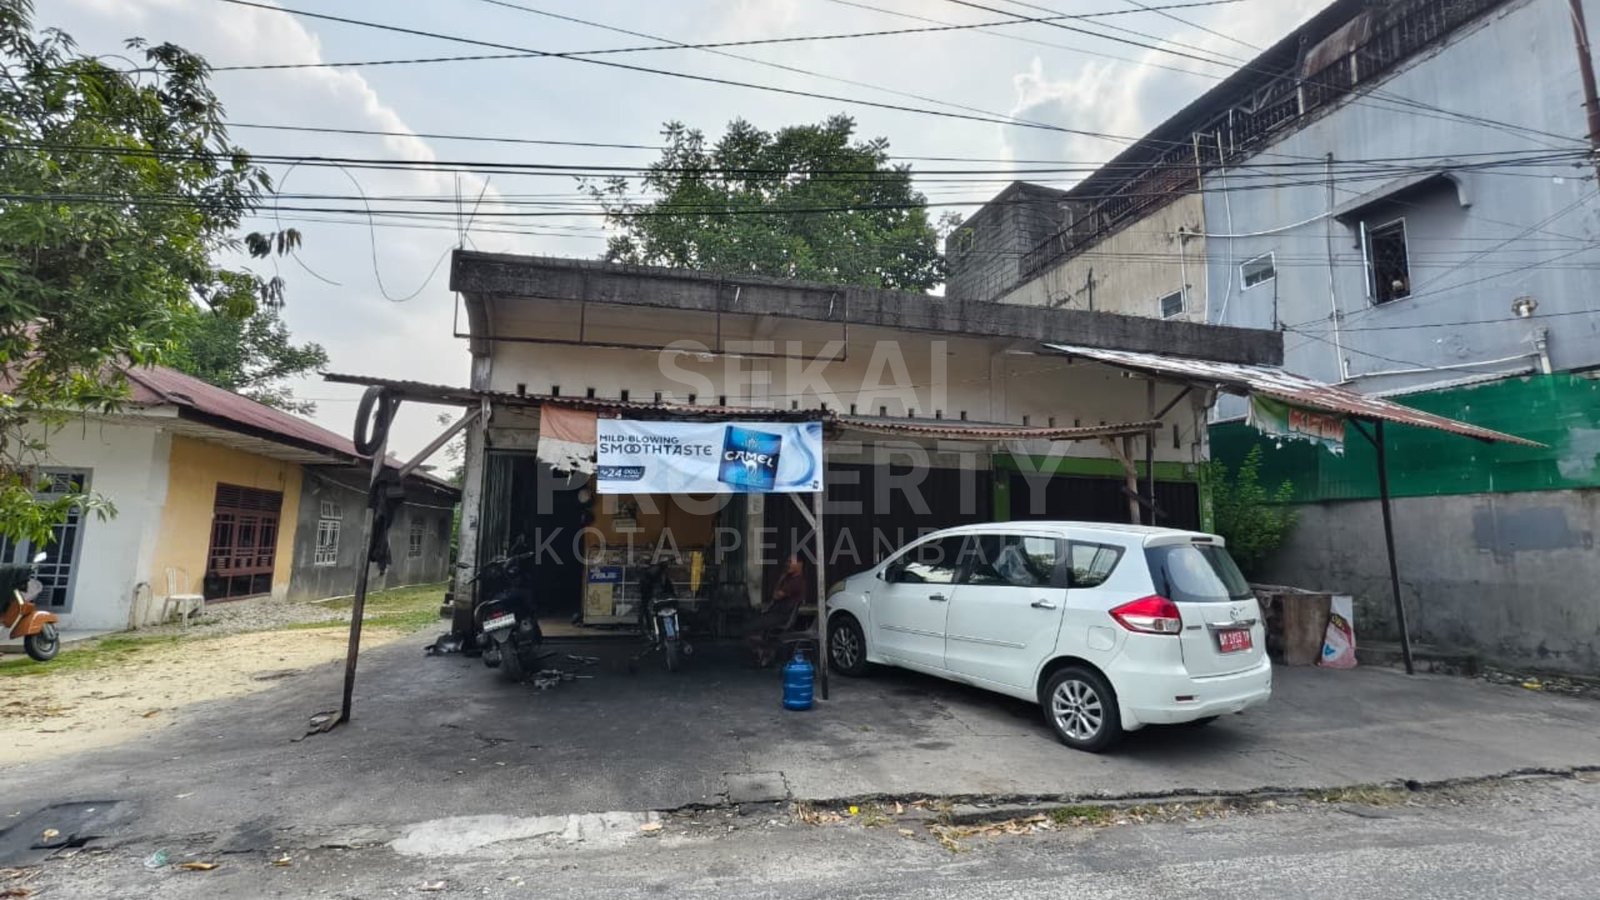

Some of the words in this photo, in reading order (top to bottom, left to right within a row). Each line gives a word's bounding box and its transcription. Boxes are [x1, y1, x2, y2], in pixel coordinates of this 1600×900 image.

[599, 434, 680, 445] MILD-BLOWING
[599, 443, 713, 457] SMOOTHTASTE
[723, 449, 774, 468] CAMEL
